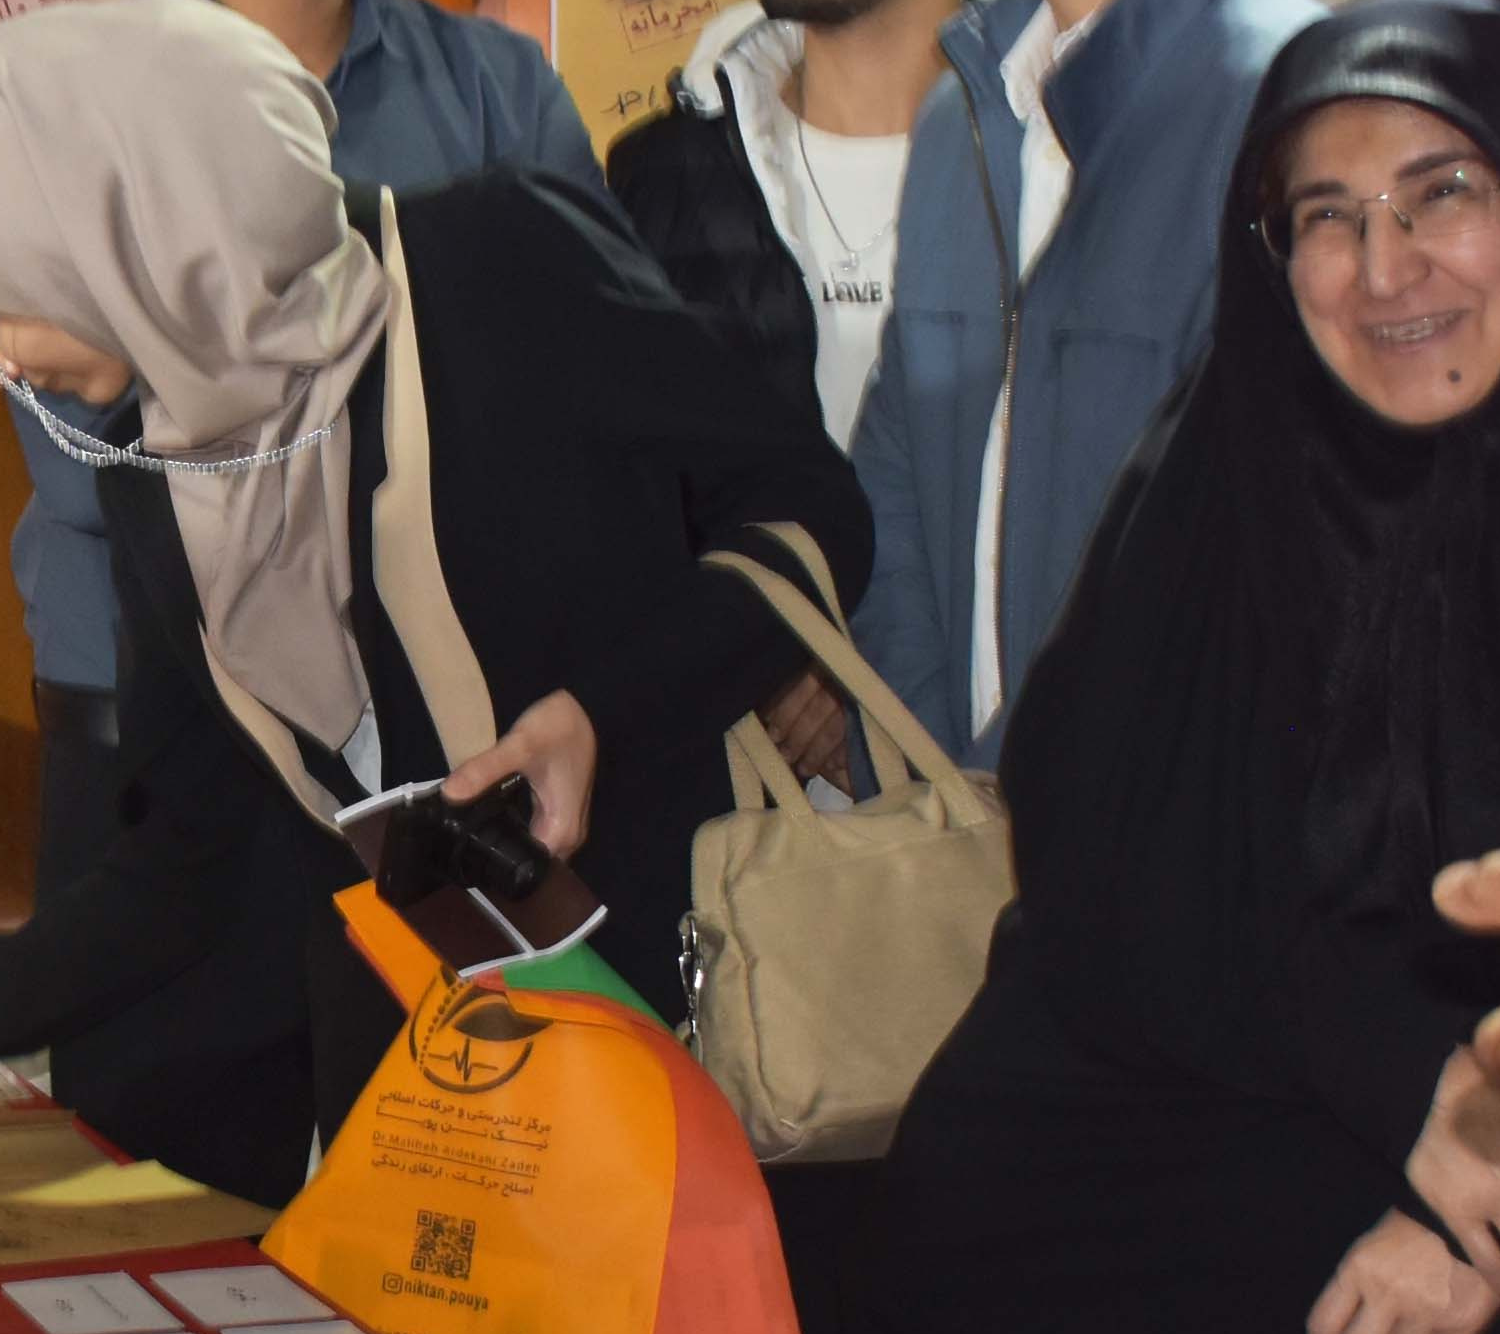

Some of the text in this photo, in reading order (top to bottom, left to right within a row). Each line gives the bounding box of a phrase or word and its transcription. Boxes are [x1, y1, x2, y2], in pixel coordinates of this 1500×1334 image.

[822, 281, 883, 302] LOVE
[378, 1091, 416, 1105] اصلاحی
[419, 1099, 456, 1115] حرکات
[467, 1110, 522, 1128] تندرستی
[525, 1118, 552, 1134] مرکز
[371, 1153, 406, 1172] زندگی
[501, 1180, 534, 1197] اصلاح
[404, 1279, 489, 1312] niktan.pouya
